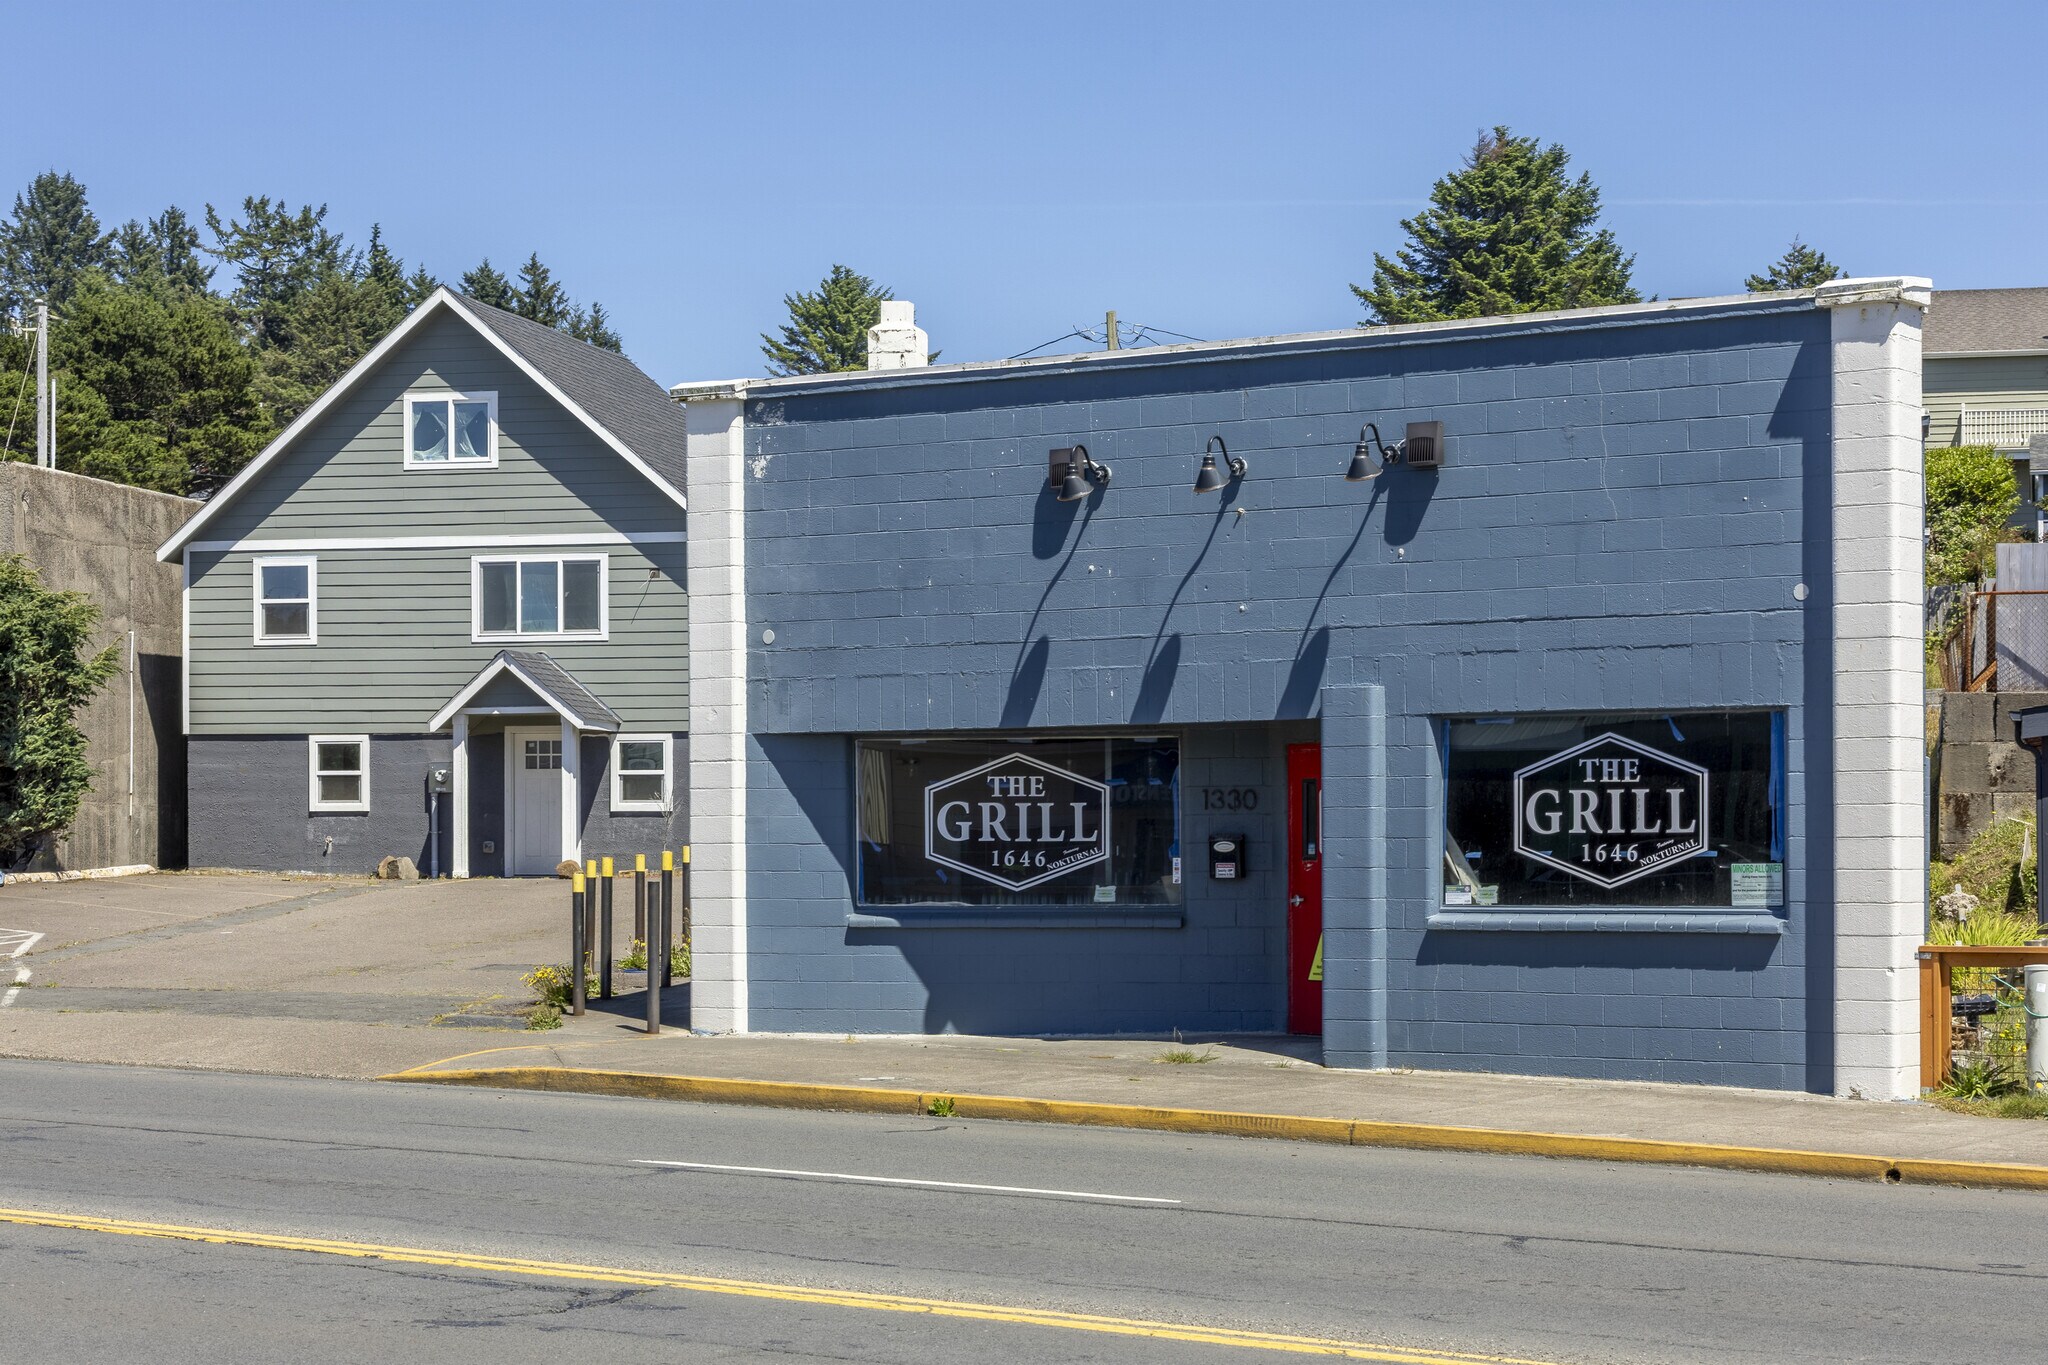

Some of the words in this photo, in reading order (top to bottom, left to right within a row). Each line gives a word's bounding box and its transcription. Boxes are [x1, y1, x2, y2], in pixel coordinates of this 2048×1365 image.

[1578, 758, 1641, 783] THE
[987, 775, 1046, 798] THE
[1202, 788, 1258, 811] 1330
[1525, 788, 1696, 835] GRILL
[936, 801, 1098, 842] GRILL
[991, 849, 1046, 867] 1646
[1046, 846, 1102, 871] NOKTURNAL
[1581, 843, 1639, 862] 1646
[1639, 838, 1698, 867] NOKTURNAL
[1732, 864, 1754, 873] MINORS
[1754, 864, 1782, 873] ALLOWED
